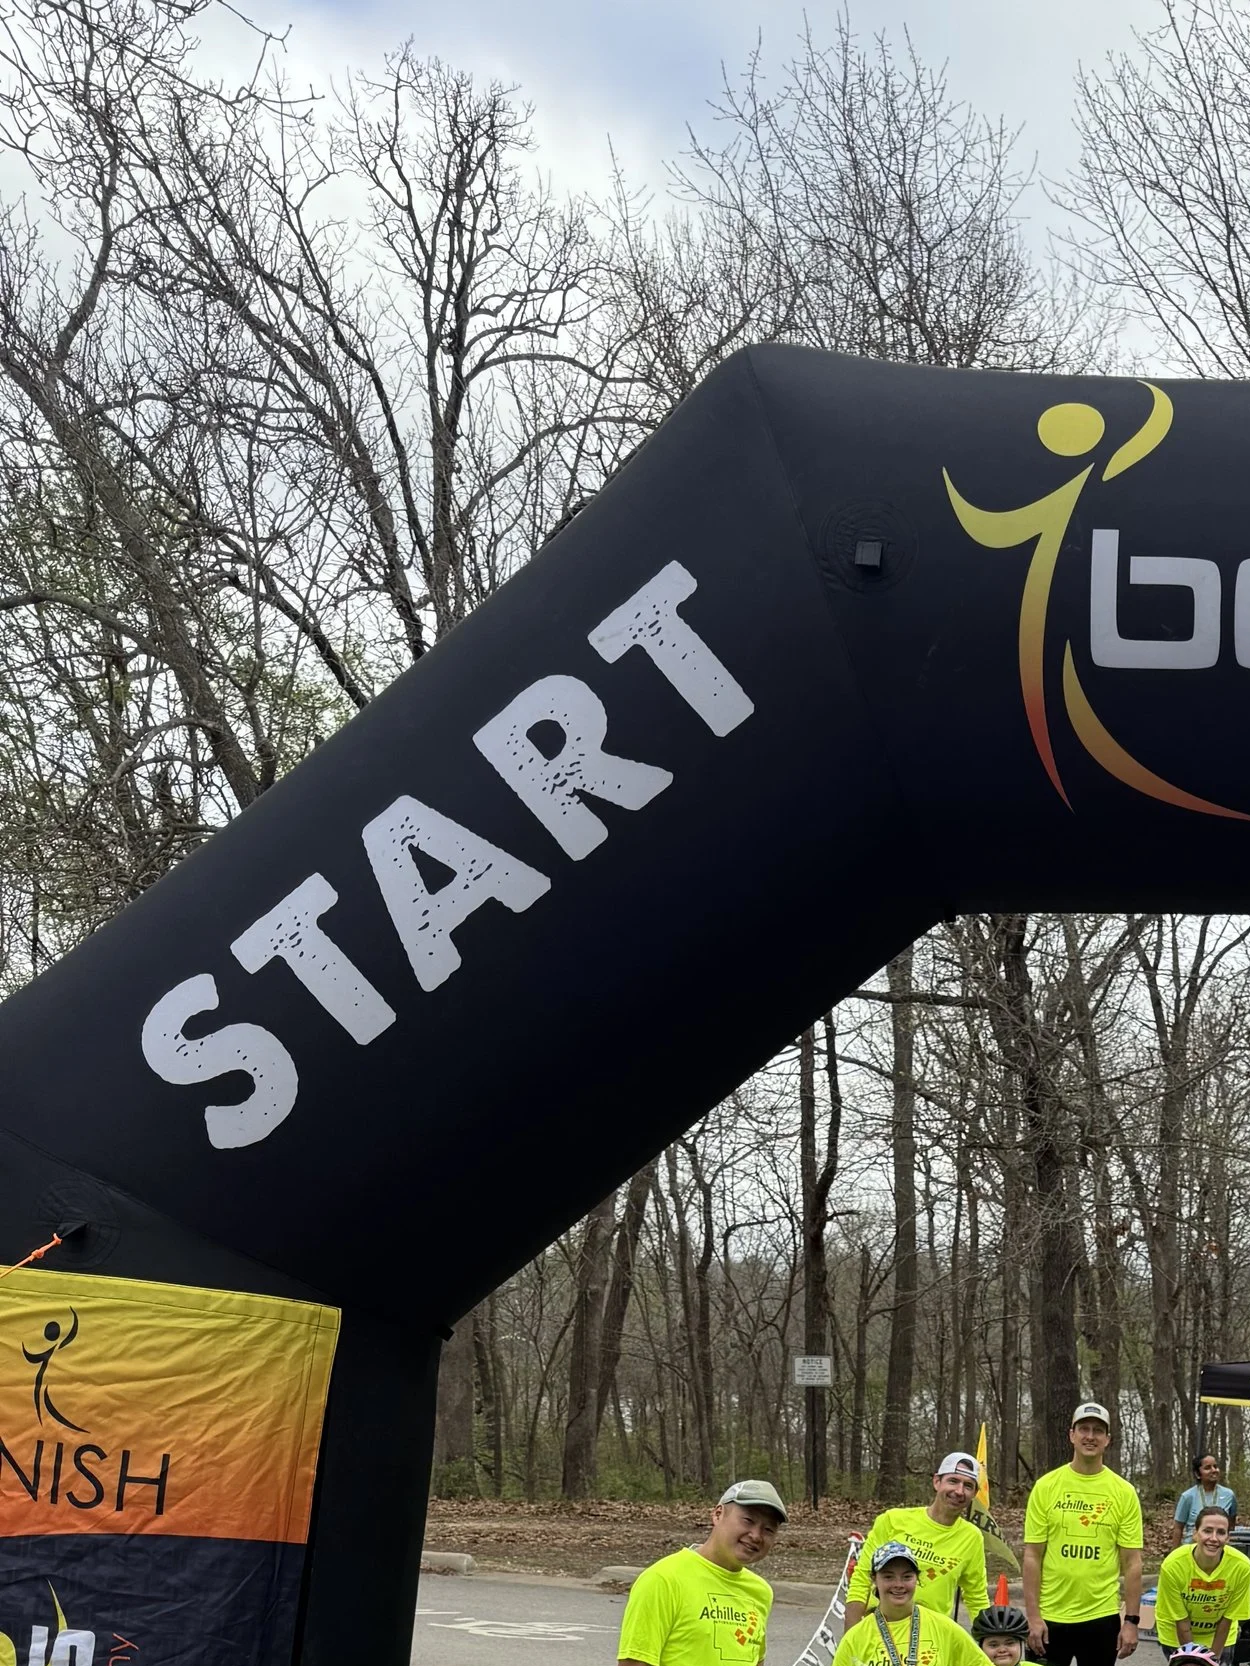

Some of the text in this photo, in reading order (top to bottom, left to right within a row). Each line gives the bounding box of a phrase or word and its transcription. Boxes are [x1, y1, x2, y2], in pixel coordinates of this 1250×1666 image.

[141, 560, 755, 1150] START
[1053, 1500, 1094, 1511] Achilles
[905, 1533, 934, 1549] Team
[911, 1548, 946, 1566] chilles
[1061, 1544, 1101, 1560] GUIDE
[700, 1606, 747, 1622] Achilles
